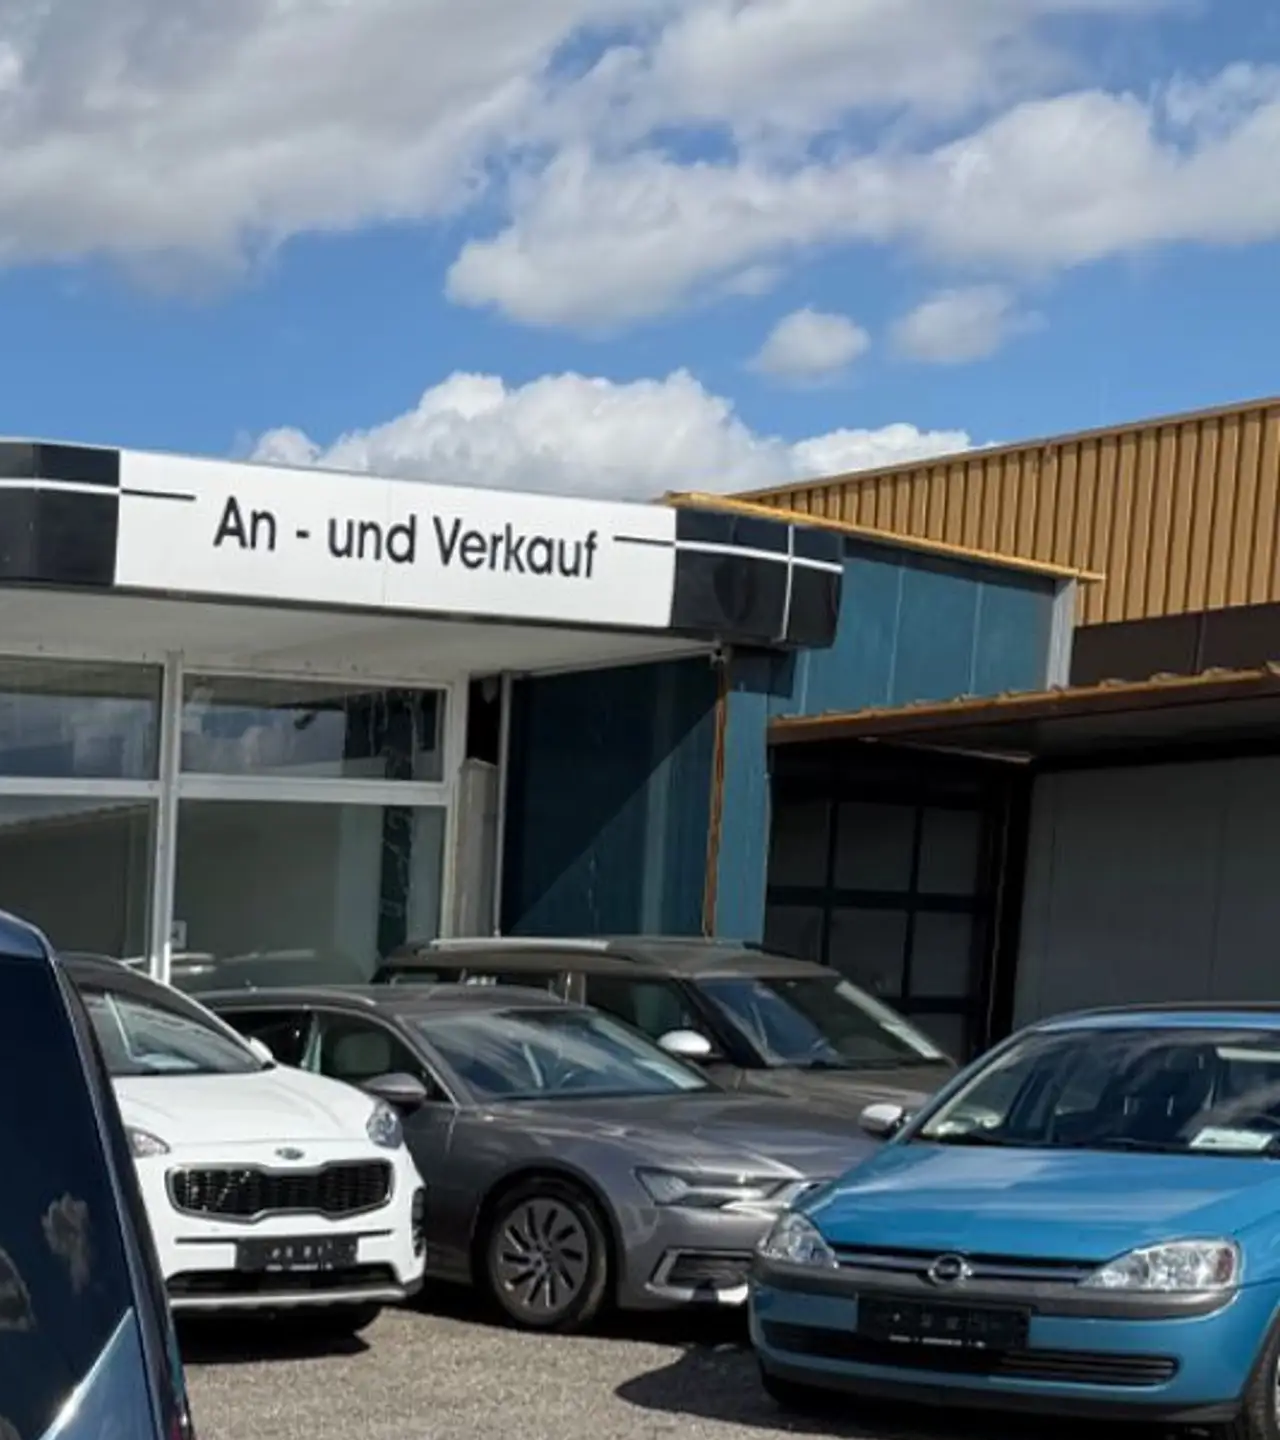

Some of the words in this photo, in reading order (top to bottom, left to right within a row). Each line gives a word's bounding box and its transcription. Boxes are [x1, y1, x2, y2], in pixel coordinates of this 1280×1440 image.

[213, 496, 277, 551] An
[328, 514, 417, 564] und
[433, 516, 598, 579] Verkauf
